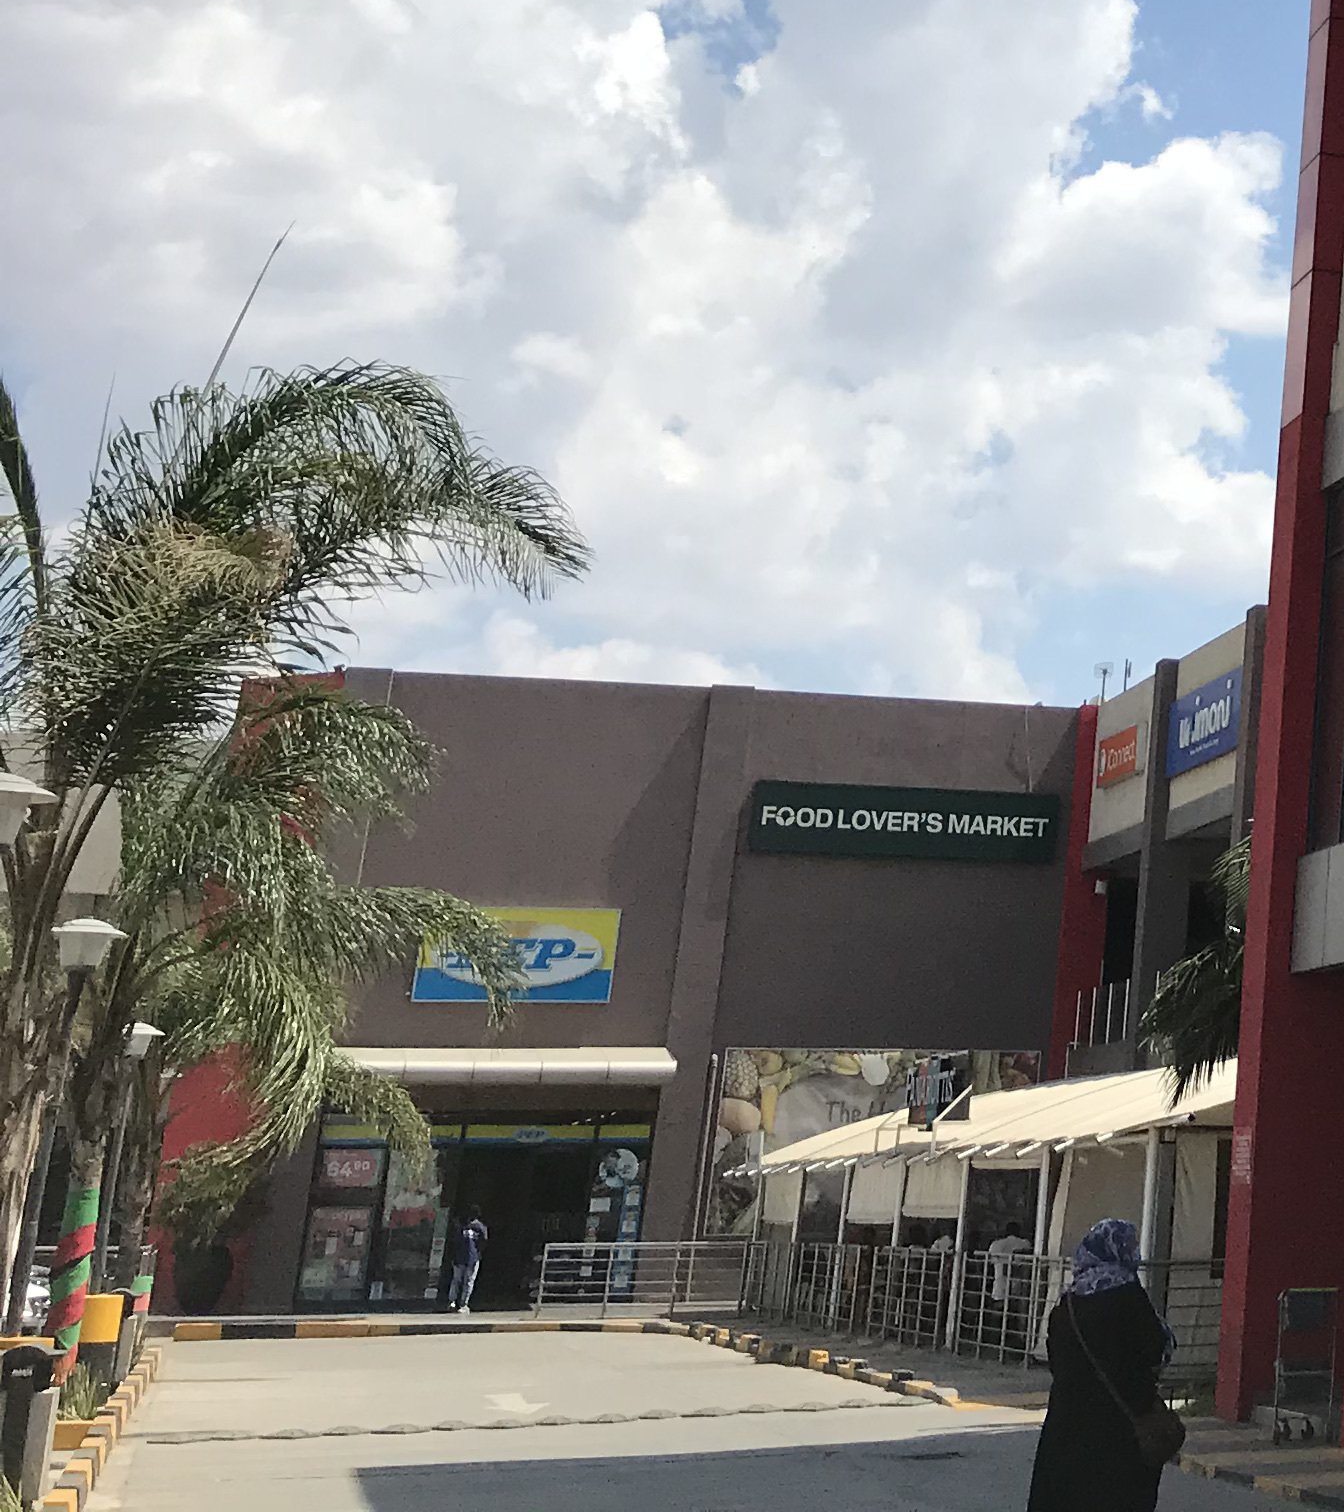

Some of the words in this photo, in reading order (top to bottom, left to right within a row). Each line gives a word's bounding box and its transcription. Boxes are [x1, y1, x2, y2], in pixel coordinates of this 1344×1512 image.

[761, 805, 834, 828] FOOD
[837, 808, 943, 834] LOVER'S
[948, 814, 1049, 837] MARKET
[825, 1099, 861, 1122] The
